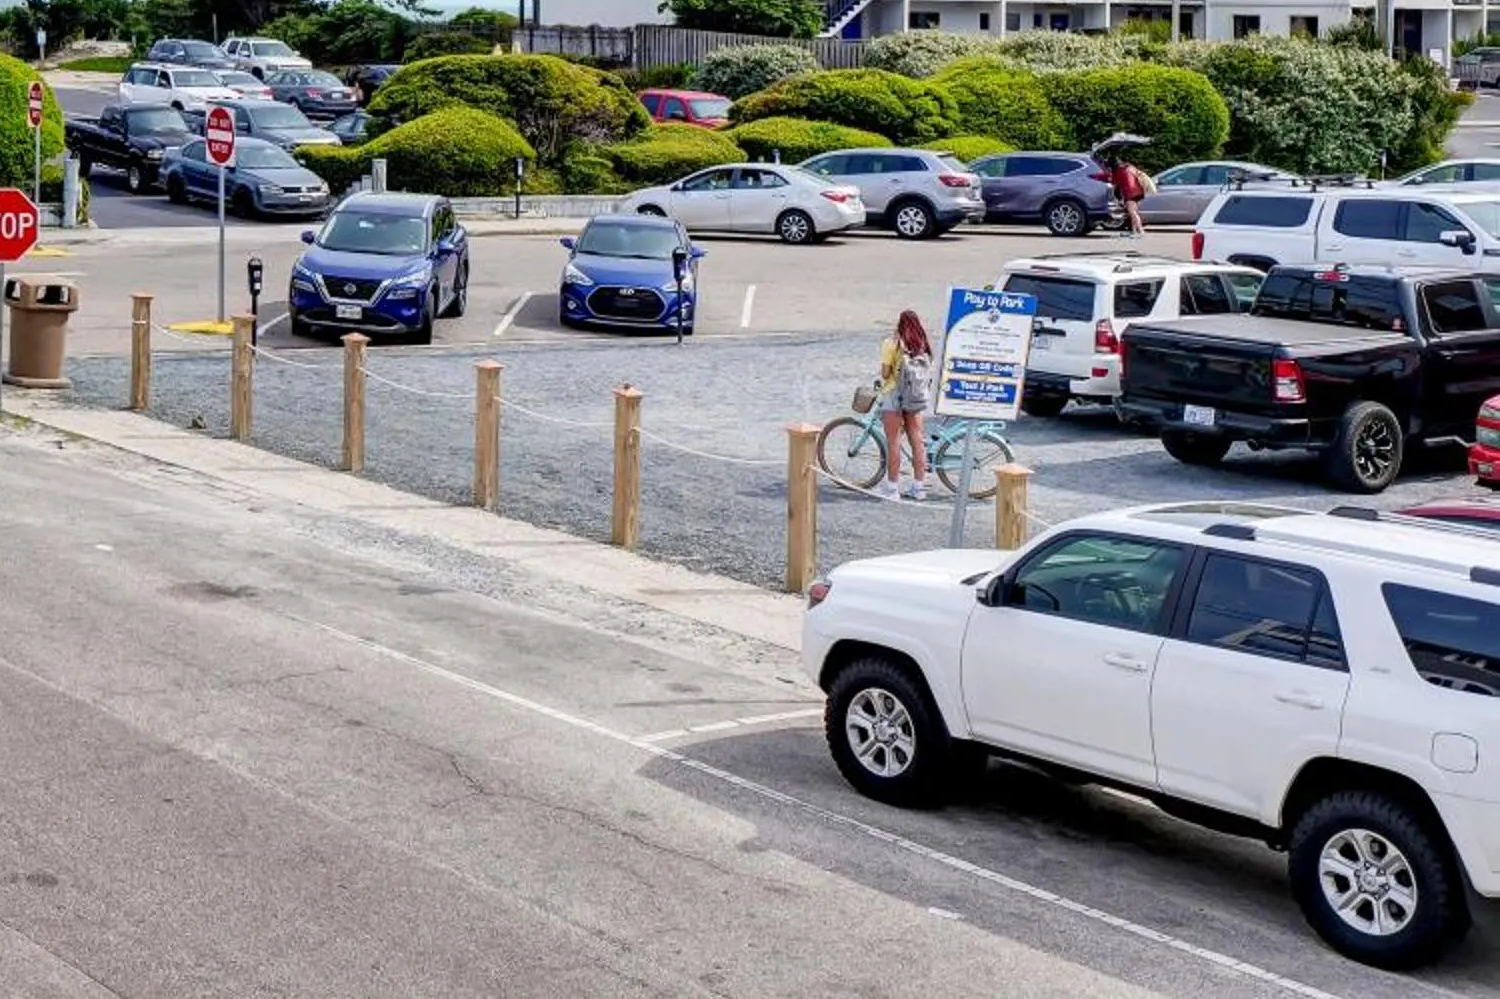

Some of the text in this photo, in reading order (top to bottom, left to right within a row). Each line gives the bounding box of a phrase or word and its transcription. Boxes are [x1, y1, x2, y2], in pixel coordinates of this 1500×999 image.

[963, 292, 1025, 309] Pay to Park
